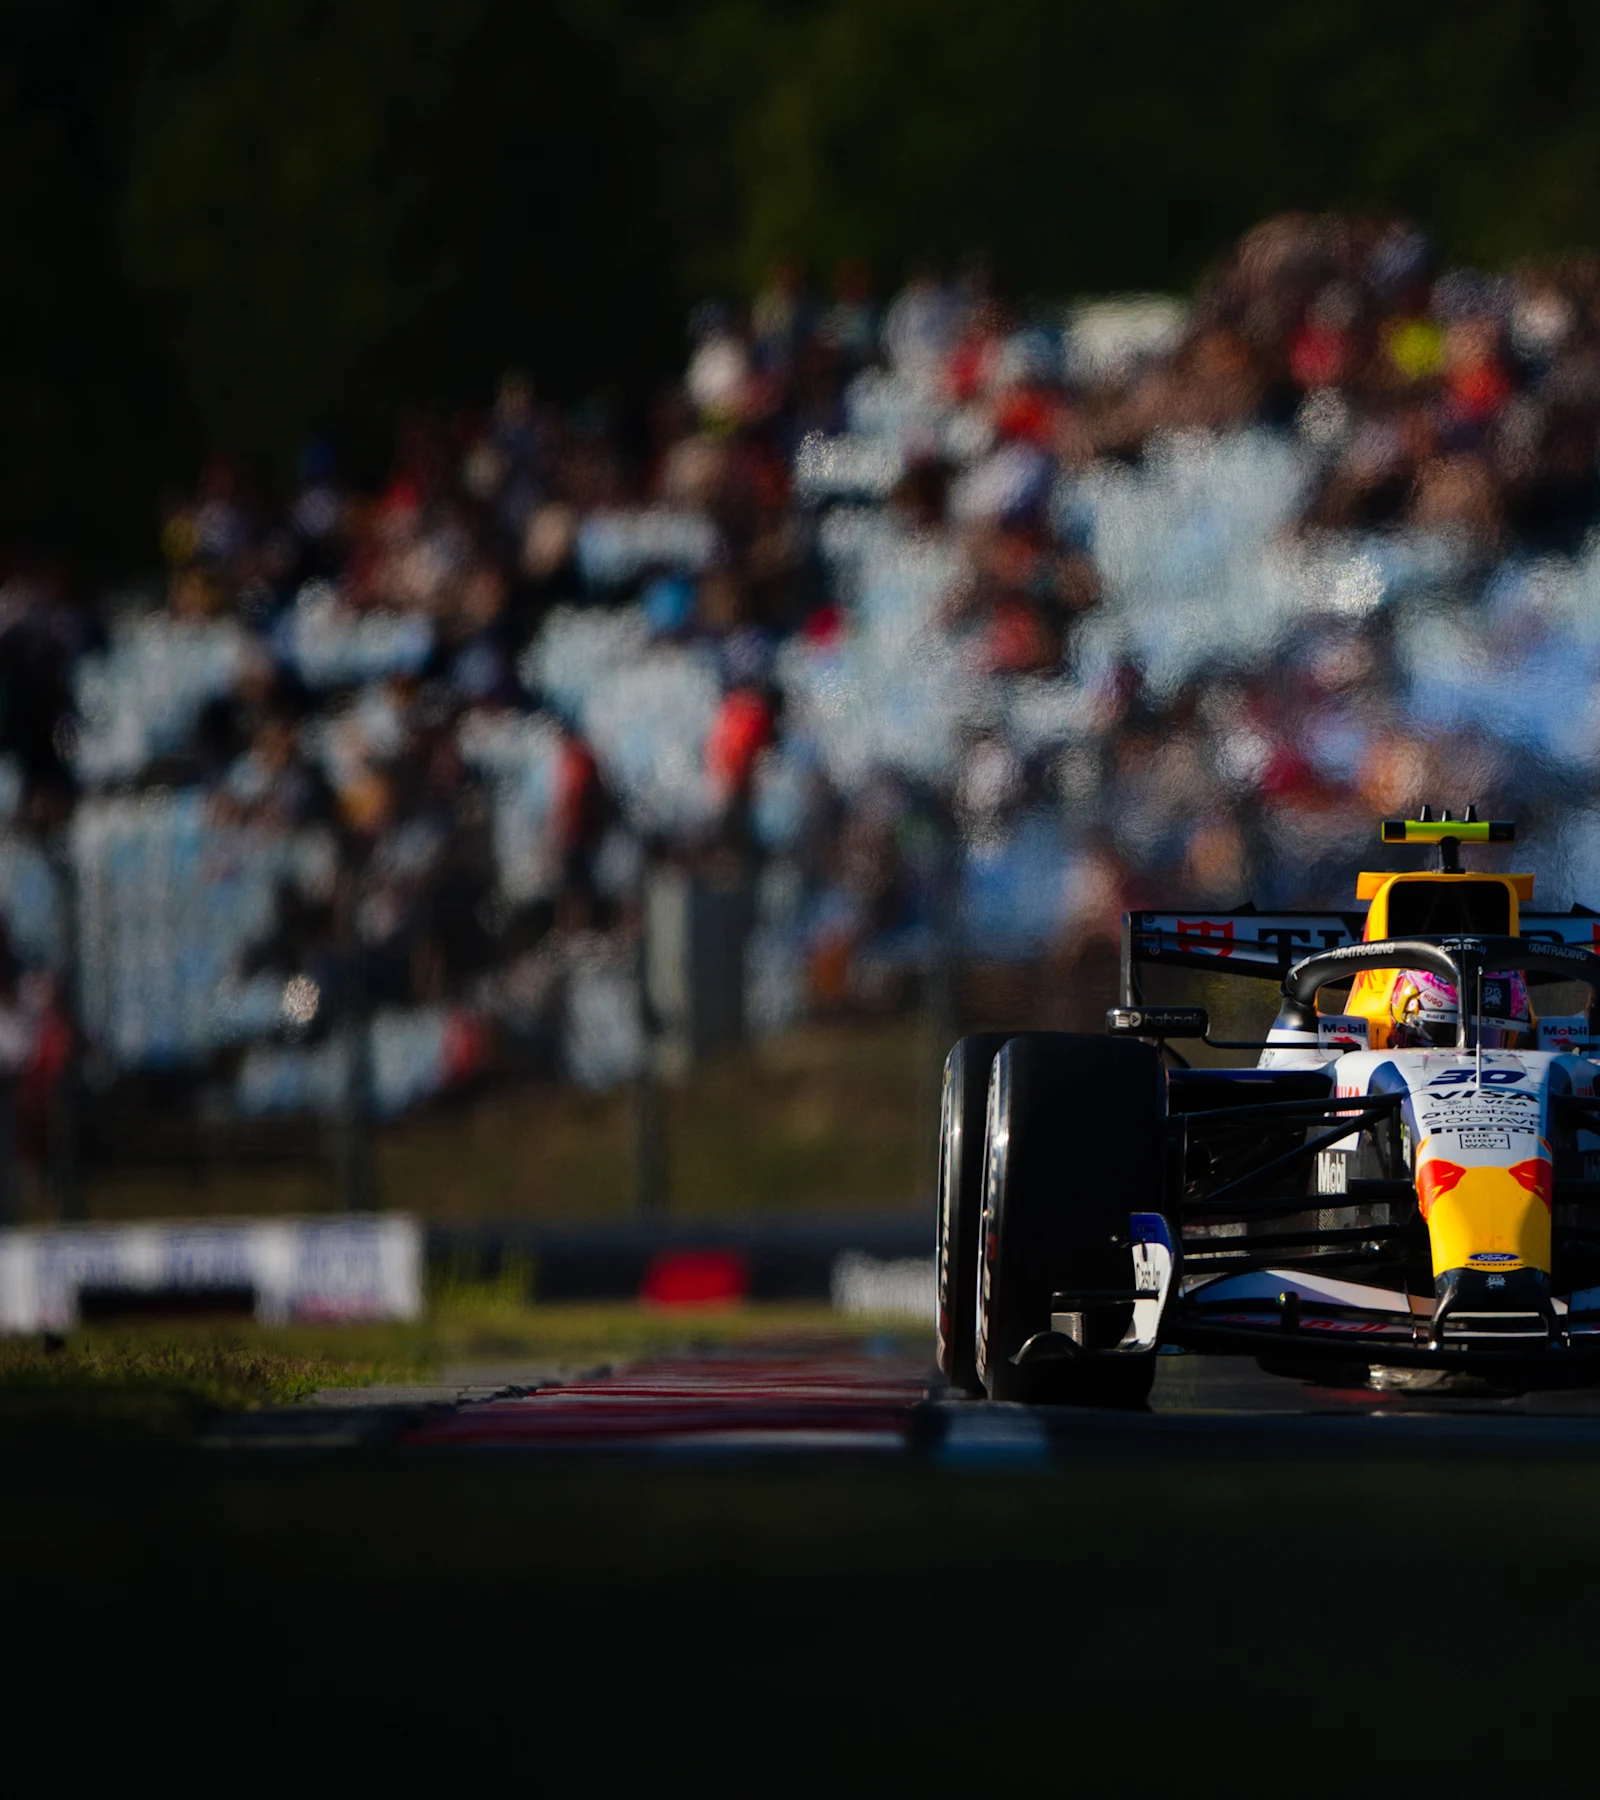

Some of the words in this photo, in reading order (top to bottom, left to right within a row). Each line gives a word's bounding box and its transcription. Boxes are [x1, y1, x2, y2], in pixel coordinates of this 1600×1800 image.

[1423, 992, 1443, 1008] HUGO
[1144, 1013, 1203, 1026] hahnair
[1323, 1024, 1366, 1034] Mobil
[1543, 1025, 1587, 1036] Mobil
[1428, 1069, 1527, 1086] 30
[1429, 1090, 1540, 1103] VISA
[1484, 1099, 1527, 1107] VISA
[1443, 1109, 1541, 1119] dynatrace
[1476, 1253, 1510, 1261] Ford
